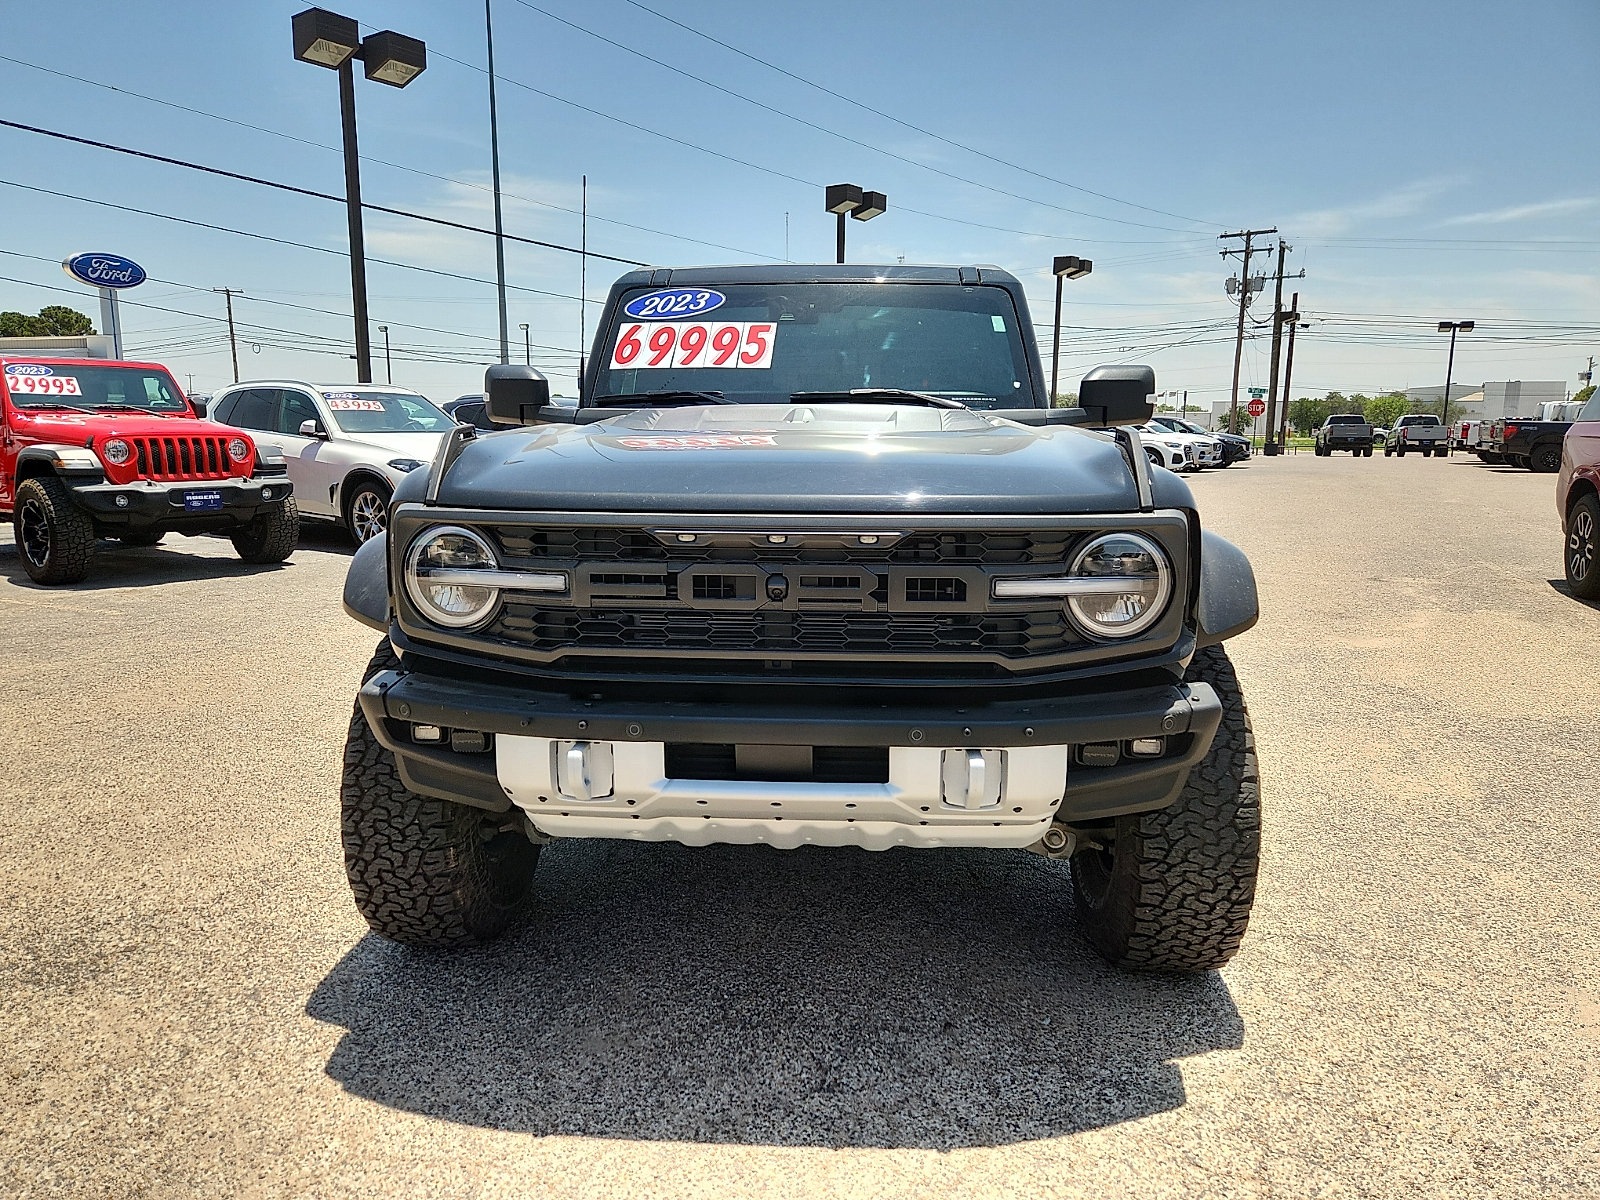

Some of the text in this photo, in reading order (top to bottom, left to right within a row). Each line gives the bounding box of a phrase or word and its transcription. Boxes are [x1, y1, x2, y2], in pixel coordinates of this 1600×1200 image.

[87, 258, 133, 282] Ford
[638, 292, 711, 316] 2023
[614, 324, 773, 367] 69995
[14, 366, 46, 375] 2023
[8, 376, 77, 394] 29995
[330, 400, 381, 410] 43995
[1248, 404, 1265, 412] STOP
[573, 563, 988, 613] FORD
